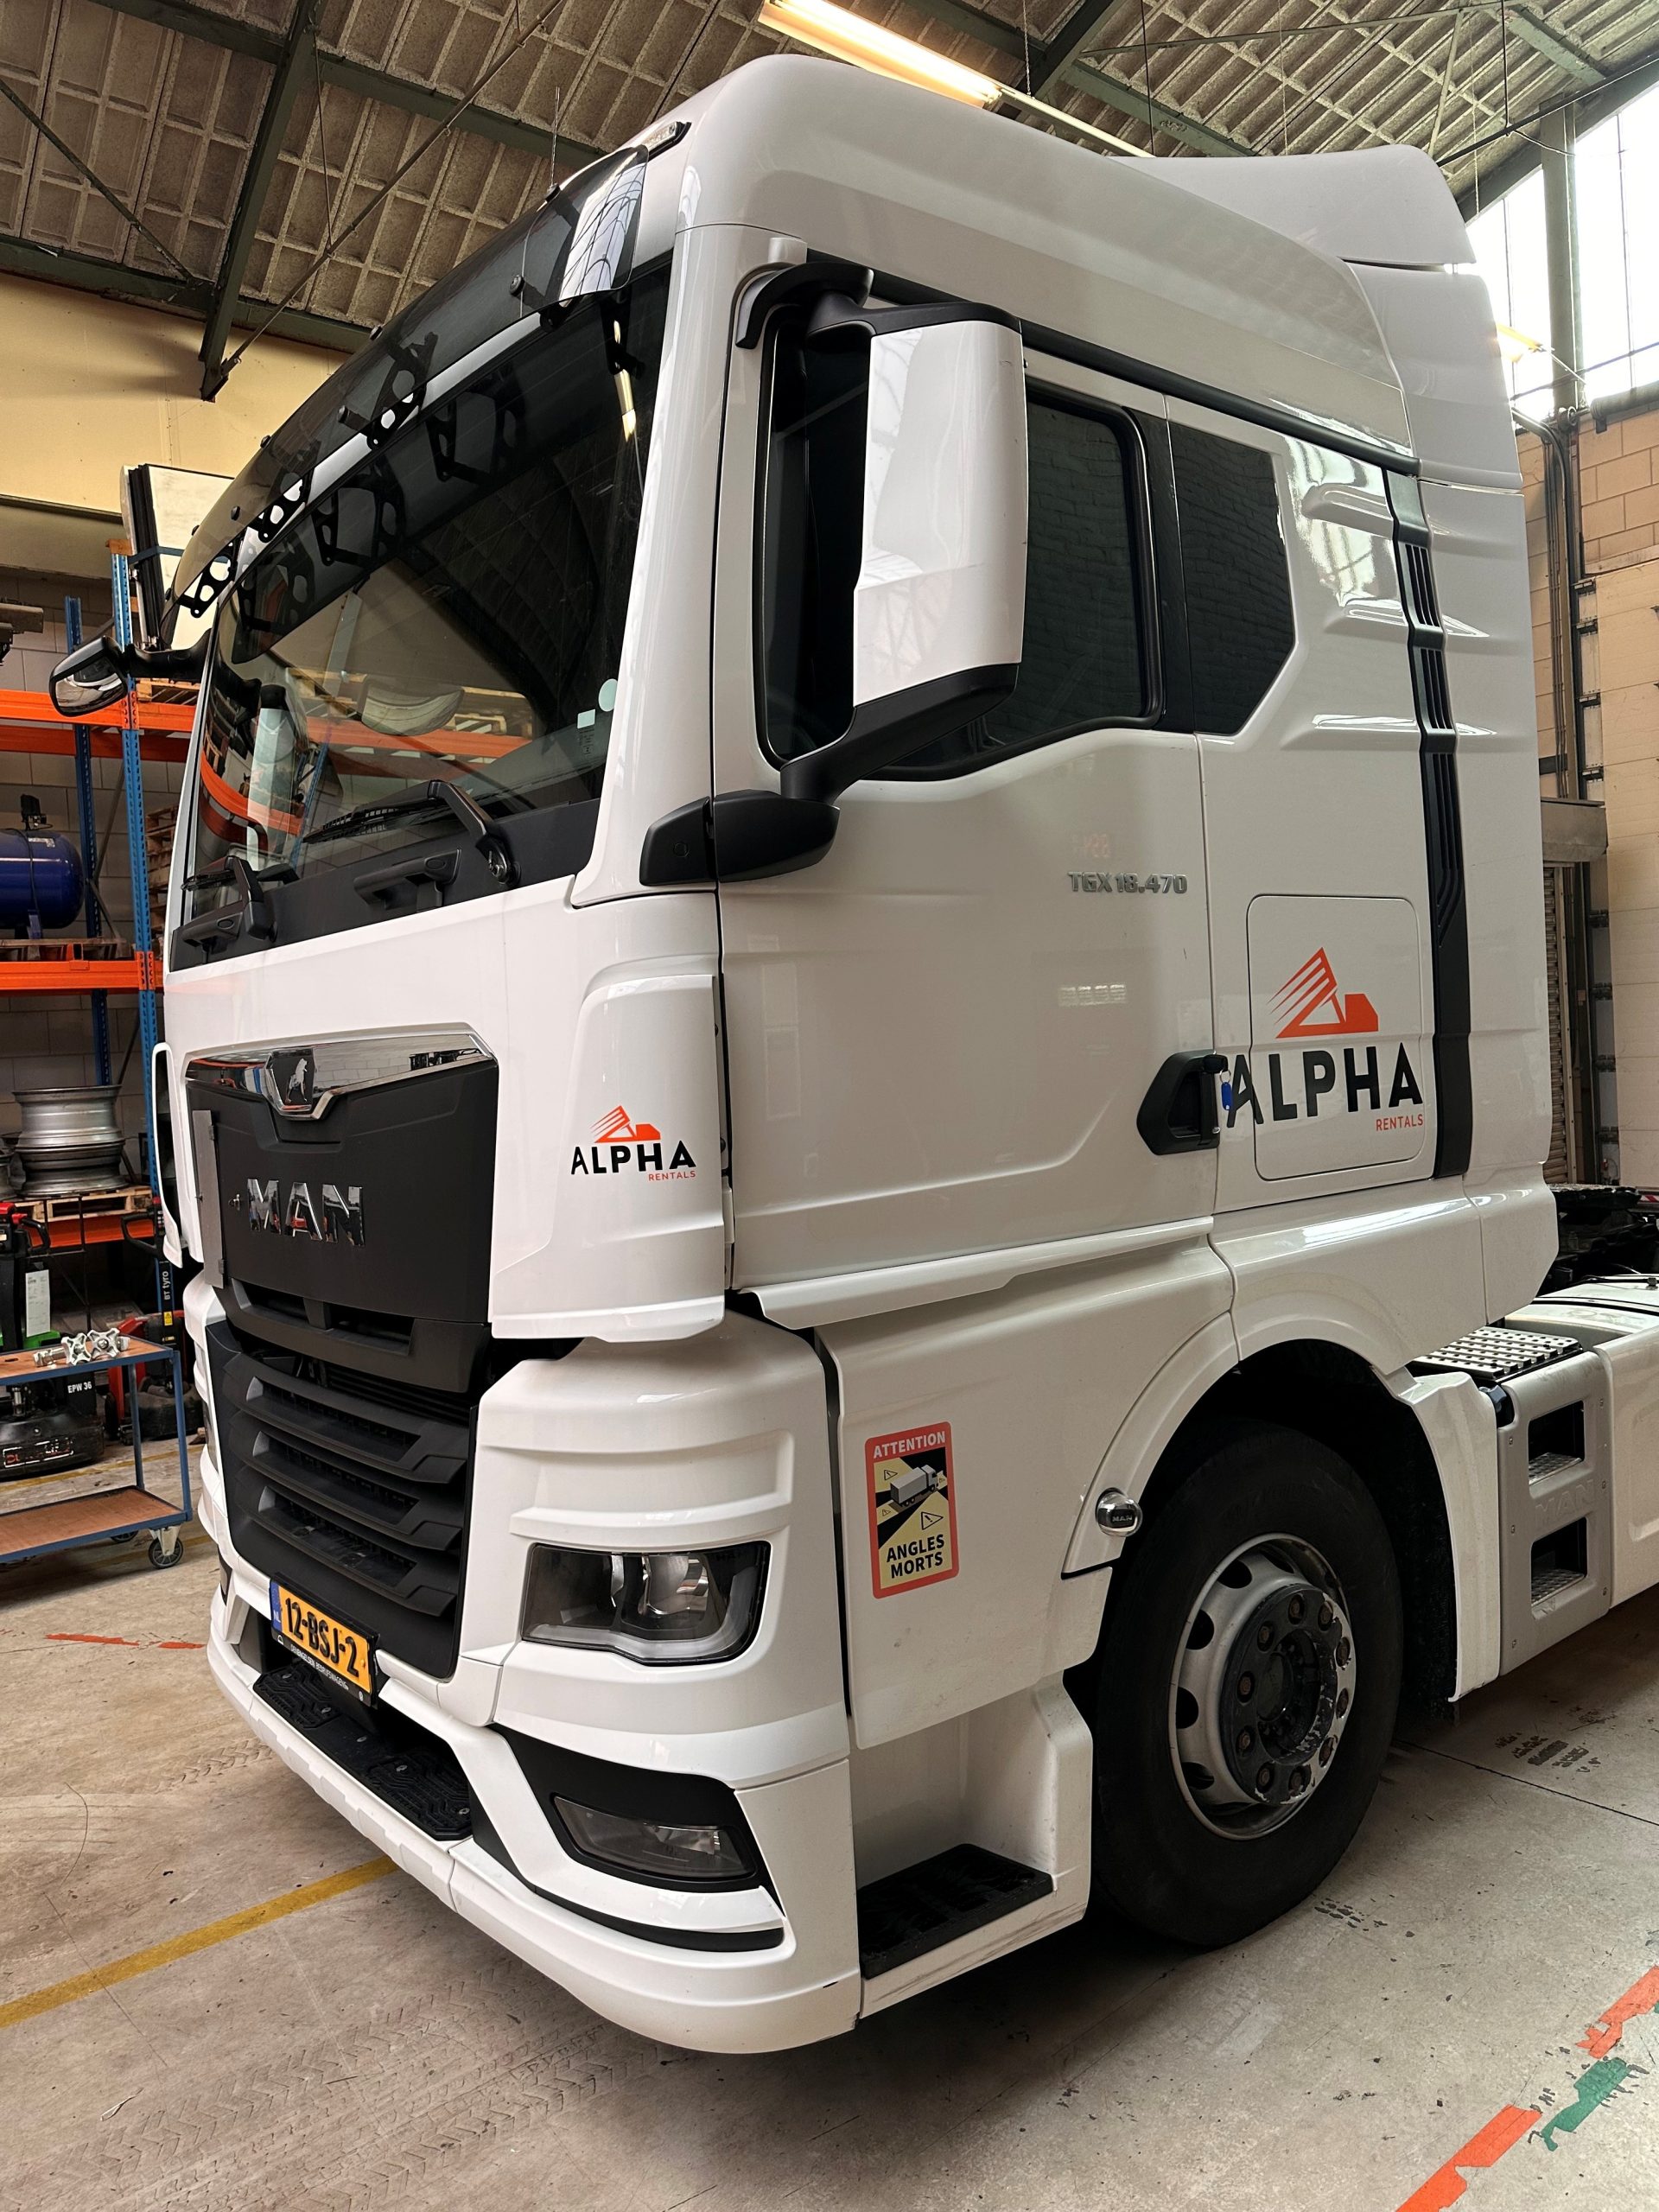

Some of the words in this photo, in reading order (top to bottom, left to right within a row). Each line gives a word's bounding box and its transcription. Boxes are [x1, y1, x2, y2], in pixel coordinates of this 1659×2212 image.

[1067, 871, 1112, 893] TGX
[1115, 873, 1188, 894] 18.470
[1226, 1042, 1424, 1128] ALPHA
[1376, 1114, 1424, 1132] RENTALS
[570, 1140, 697, 1175] ALPHA
[648, 1170, 696, 1182] RENTALS
[247, 1179, 365, 1247] MAN
[162, 1270, 171, 1289] tyro
[67, 1383, 83, 1394] EPW
[83, 1381, 92, 1390] 36
[873, 1431, 946, 1459] ATTENTION
[886, 1534, 945, 1563] ANGLES
[890, 1551, 944, 1579] MORTS
[285, 1597, 359, 1678] 12-BSJ-2
